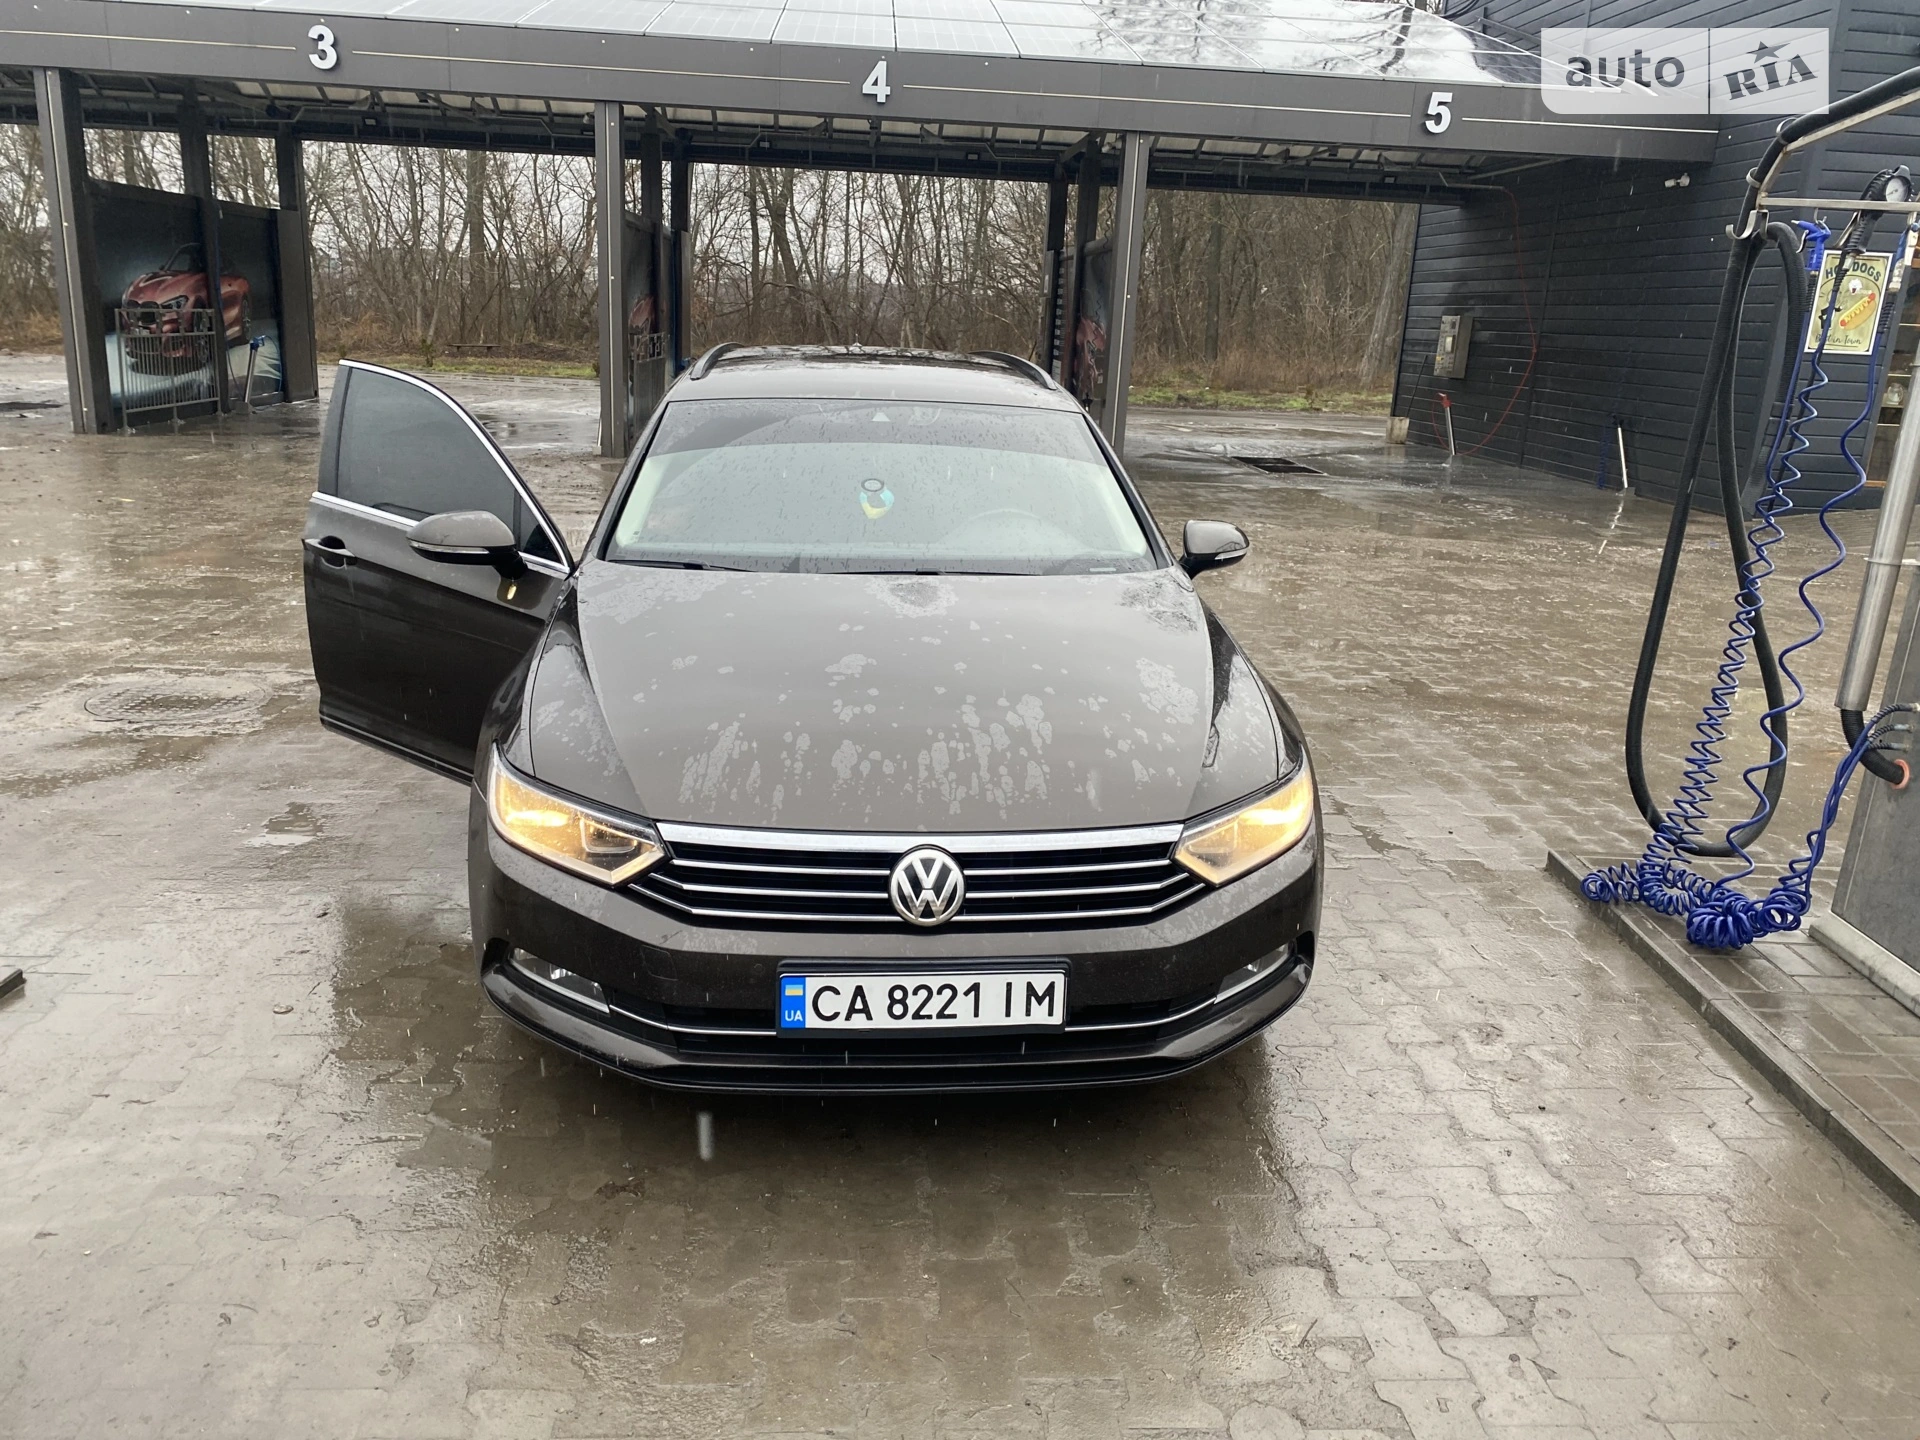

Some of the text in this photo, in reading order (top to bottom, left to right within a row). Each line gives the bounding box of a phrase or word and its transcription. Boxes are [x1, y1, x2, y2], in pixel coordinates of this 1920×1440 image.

[307, 24, 338, 71] 3
[861, 60, 891, 104] 4
[1424, 91, 1453, 134] 5
[1852, 261, 1882, 282] DOGS
[1844, 334, 1862, 345] Town
[896, 855, 959, 921] VW
[784, 1009, 804, 1022] UA
[811, 981, 1056, 1022] CA 8221 IM
